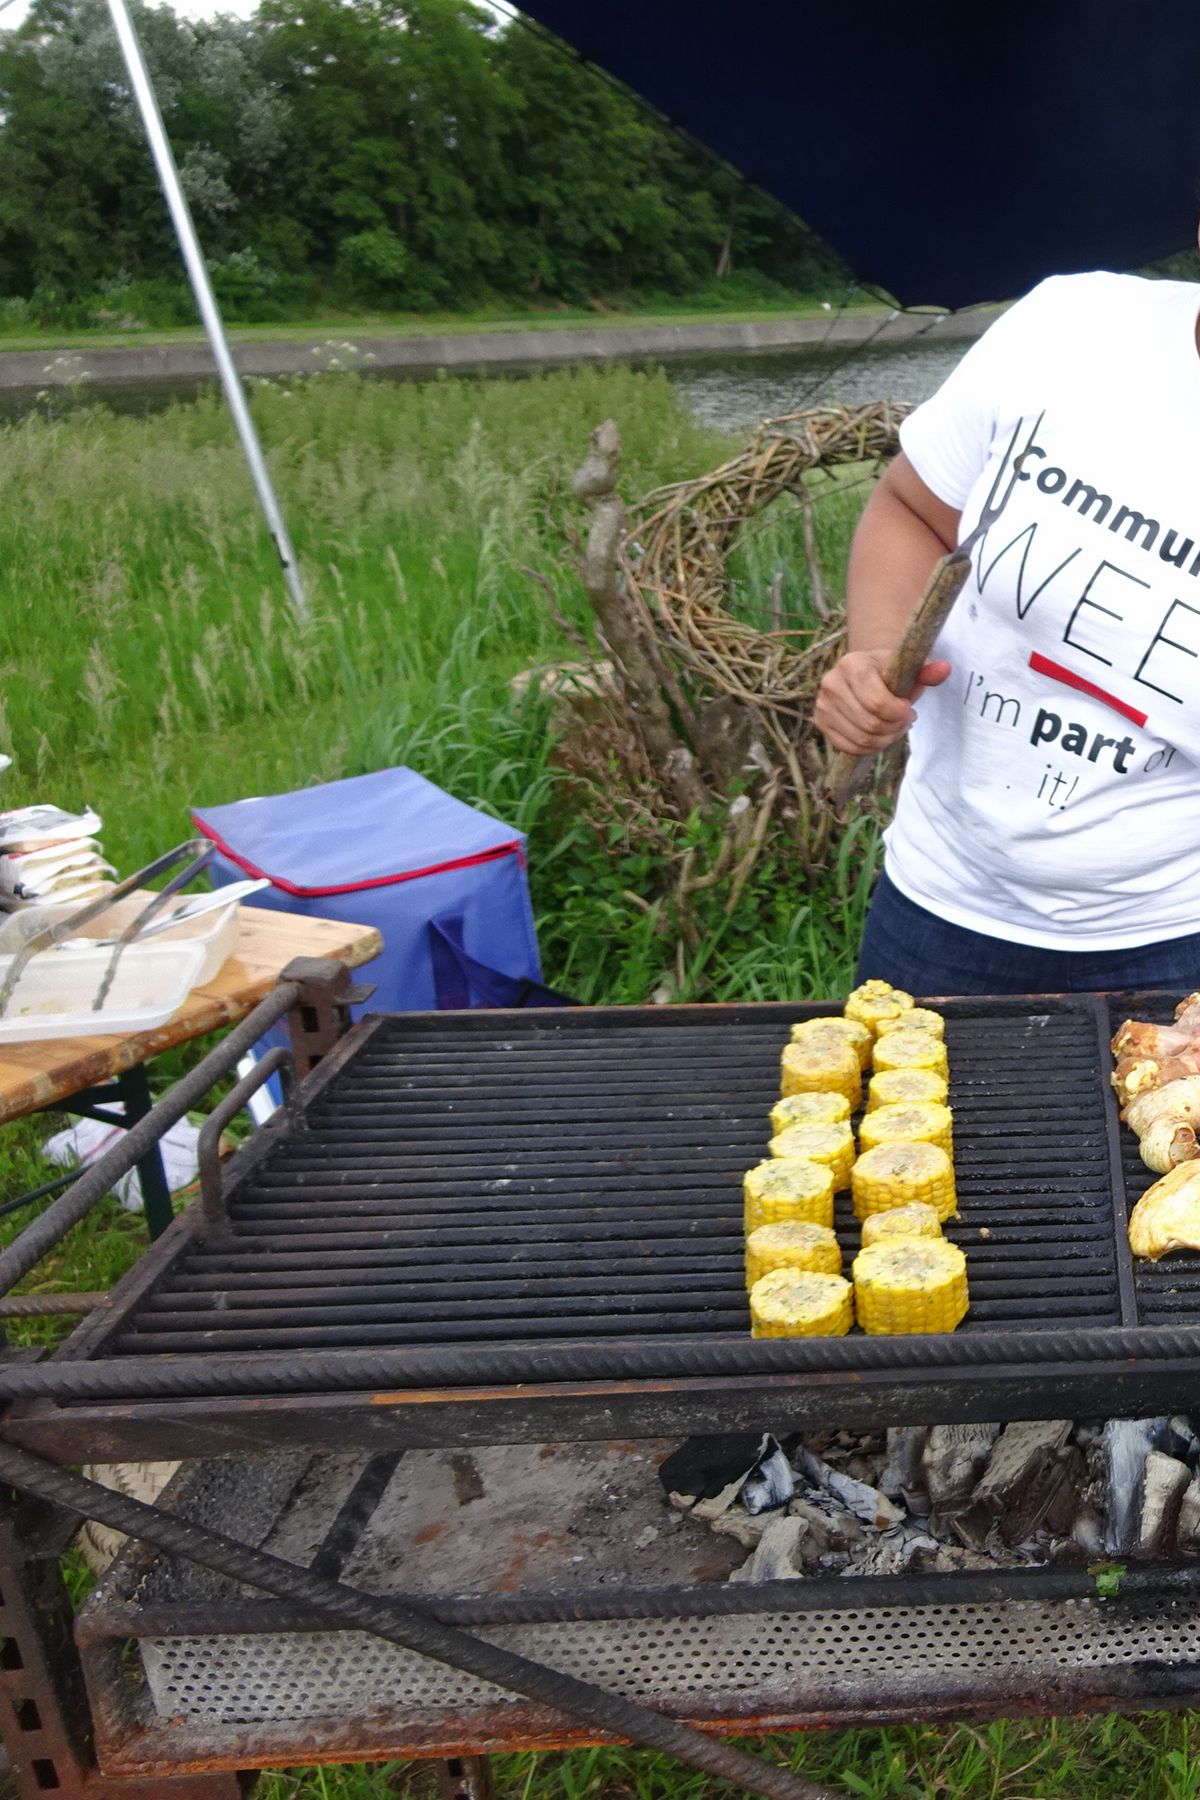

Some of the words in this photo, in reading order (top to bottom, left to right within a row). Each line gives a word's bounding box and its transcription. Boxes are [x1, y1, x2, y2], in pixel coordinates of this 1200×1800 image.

[964, 671, 1021, 727] I'm
[1030, 707, 1136, 774] part
[1037, 763, 1080, 811] it!
